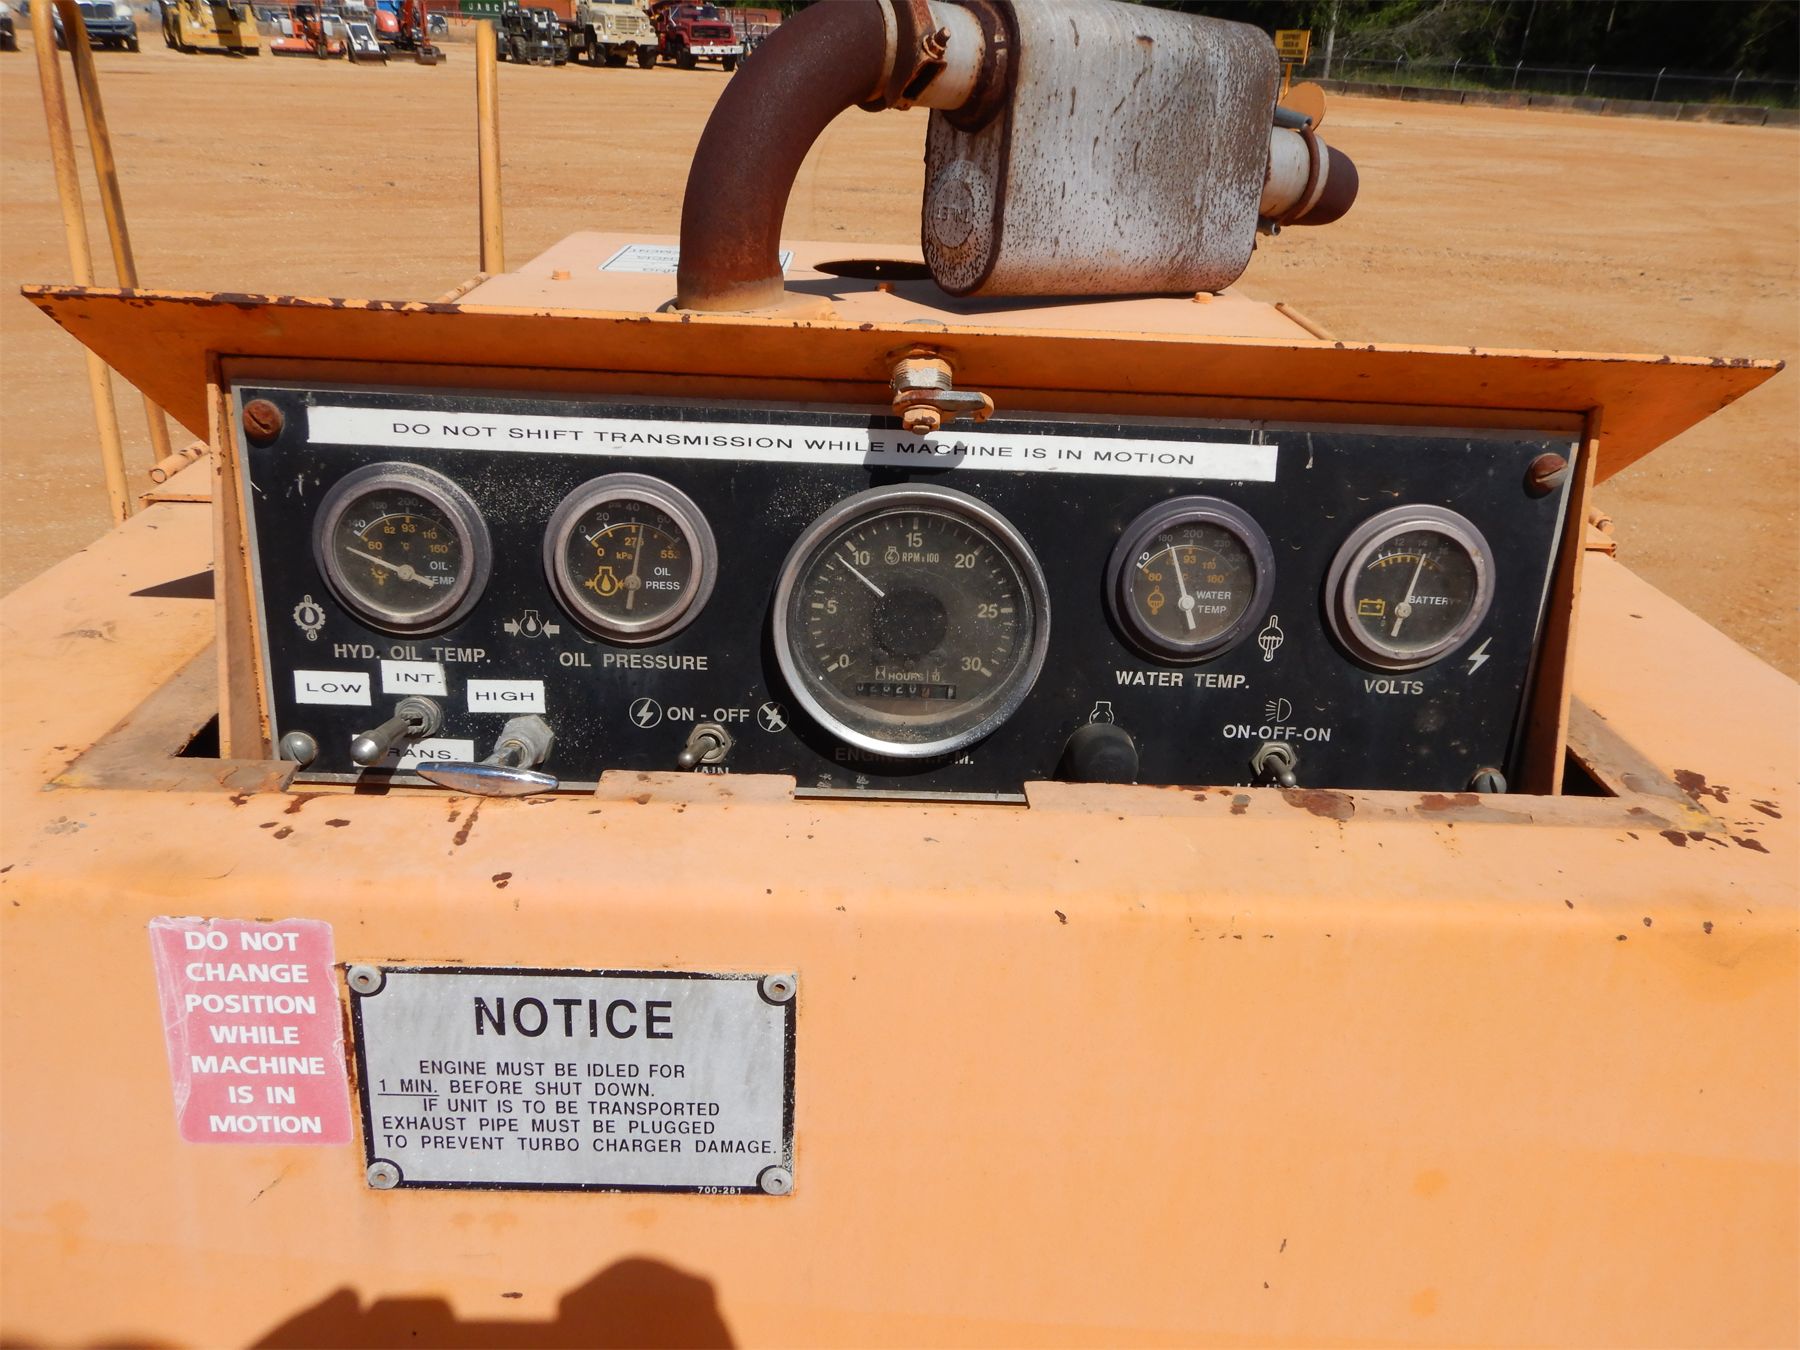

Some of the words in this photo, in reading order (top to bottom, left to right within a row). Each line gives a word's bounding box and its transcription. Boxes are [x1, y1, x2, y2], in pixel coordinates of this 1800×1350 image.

[392, 422, 431, 435] DO
[443, 425, 497, 438] NOT
[508, 426, 584, 442] SHIFT
[594, 430, 794, 450] TRANSMISSION
[804, 438, 886, 453] WHILE
[896, 442, 1013, 458] MACHINE
[1024, 447, 1047, 460] IS
[1057, 448, 1083, 461] IN
[1093, 450, 1196, 466] MOTION
[625, 502, 640, 512] 40
[596, 512, 610, 521] 20
[401, 523, 416, 533] 93
[1183, 529, 1204, 538] 200
[905, 532, 923, 548] 15
[429, 560, 449, 571] OIL
[853, 550, 870, 566] 10
[901, 552, 921, 563] RPM
[926, 553, 940, 564] 100
[954, 553, 976, 569] 20
[653, 566, 672, 577] OIL
[645, 580, 681, 591] PRESS
[1196, 591, 1232, 600] WATER
[1408, 595, 1454, 606] BATTER
[826, 599, 838, 615] 5
[977, 603, 999, 619] 25
[1197, 605, 1227, 614] TEMP
[333, 643, 380, 660] HYD.
[391, 645, 423, 661] OIL
[431, 646, 491, 664] TEMP.
[559, 651, 592, 667] OIL
[603, 652, 709, 671] PRESSURE
[838, 653, 850, 669] 0
[961, 657, 982, 672] 30
[396, 672, 442, 685] INT.
[888, 671, 925, 682] HOURS
[1116, 670, 1184, 687] WATER
[1194, 673, 1250, 689] TEMP.
[305, 682, 362, 694] LOW
[1363, 679, 1424, 696] VOLTS
[475, 691, 535, 702] HIGH
[666, 706, 695, 721] ON
[712, 707, 750, 723] OFF
[1222, 723, 1331, 742] ON-OFF-ON
[387, 747, 459, 760] RANS.
[184, 930, 229, 951] DO
[240, 931, 300, 952] NOT
[185, 963, 310, 984] CHANGE
[184, 994, 317, 1015] POSITION
[473, 996, 674, 1040] NOTICE
[209, 1025, 301, 1045] WHILE
[190, 1055, 326, 1075] MACHINE
[419, 1060, 487, 1075] ENGINE
[496, 1061, 545, 1076] MUST
[555, 1063, 578, 1077] BE
[587, 1063, 640, 1078] IDLED
[649, 1064, 686, 1079] FOR
[228, 1085, 254, 1104] IS
[265, 1086, 297, 1105] IN
[378, 1079, 387, 1092] 1
[399, 1079, 438, 1093] MIN.
[450, 1080, 523, 1095] BEFORE
[535, 1081, 583, 1096] SHUT
[594, 1082, 656, 1098] DOWN.
[423, 1098, 438, 1112] IF
[448, 1099, 488, 1113] UNIT
[497, 1100, 513, 1114] IS
[522, 1100, 546, 1114] TO
[555, 1100, 578, 1115] BE
[588, 1101, 720, 1116] TRANSPORTED
[208, 1115, 323, 1134] MOTION
[382, 1116, 466, 1131] EXHAUST
[479, 1117, 519, 1132] PIPE
[531, 1118, 581, 1133] MUST
[593, 1119, 616, 1134] BE
[628, 1120, 716, 1135] PLUGGED
[383, 1134, 408, 1149] TO
[421, 1135, 505, 1150] PREVENT
[517, 1137, 580, 1152] TURBO
[592, 1138, 682, 1153] CHARGER
[695, 1140, 777, 1154] DAMAGE.
[698, 1186, 742, 1195] 700-281
